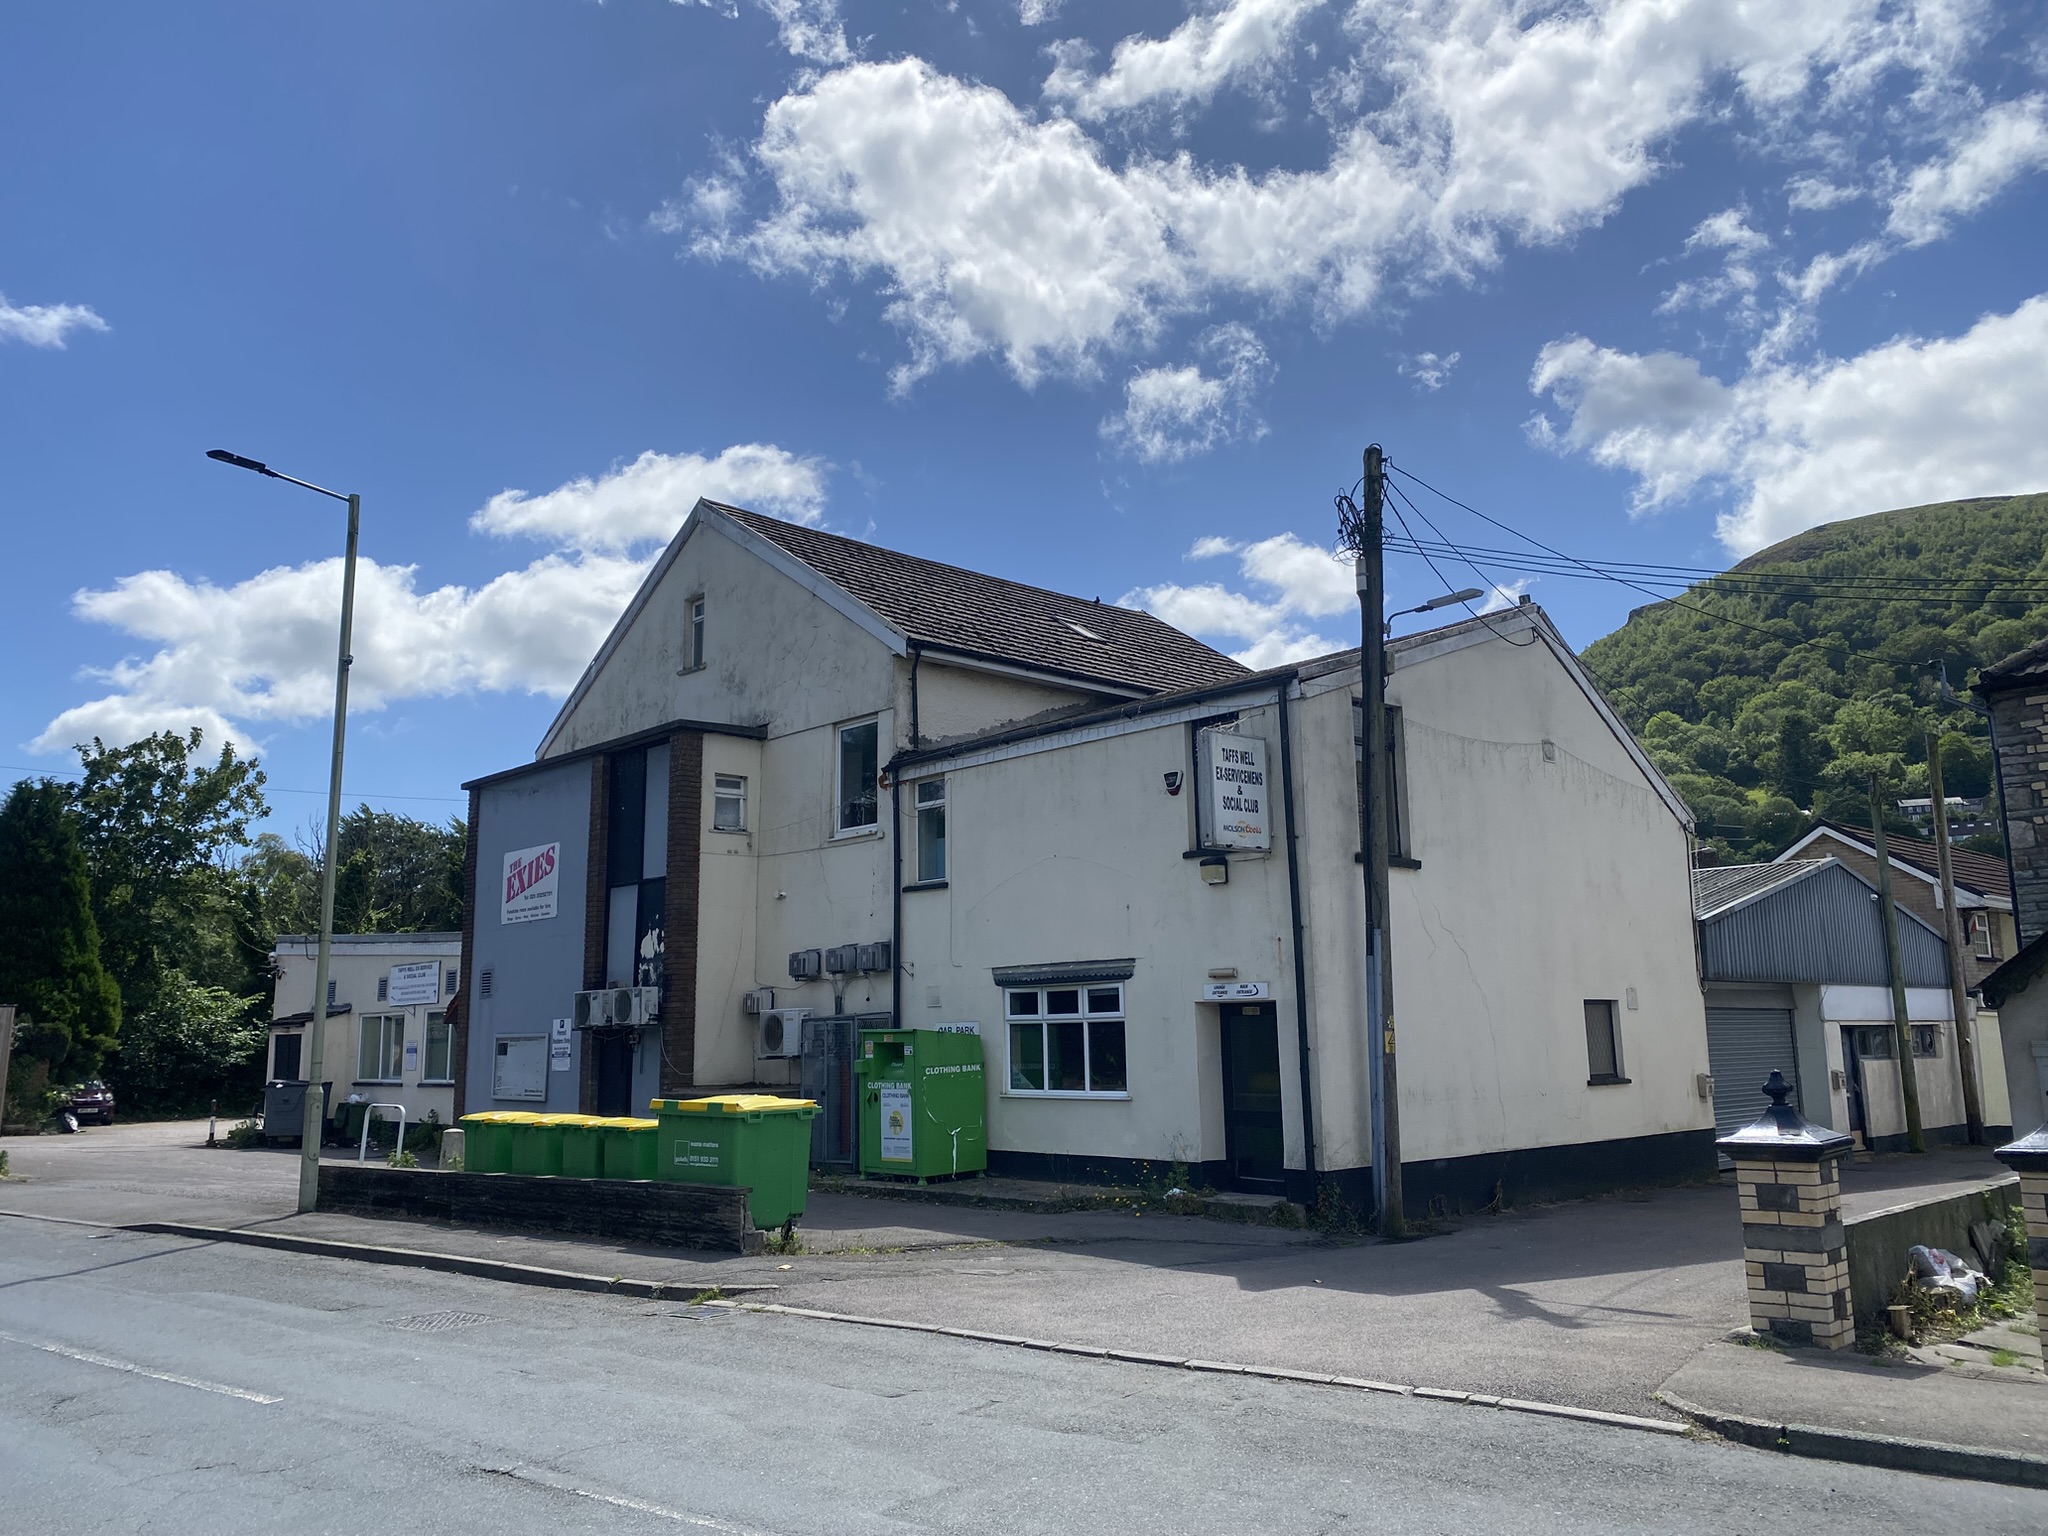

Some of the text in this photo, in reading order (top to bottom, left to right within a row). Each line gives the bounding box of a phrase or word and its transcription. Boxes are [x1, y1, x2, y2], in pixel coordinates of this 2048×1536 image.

[1222, 748, 1255, 766] TAFFS WELL
[1216, 766, 1263, 786] EX-SERVICEMENS
[1237, 785, 1243, 796] &
[1222, 795, 1259, 813] SOCIAL CLUB
[1223, 824, 1262, 834] MOLSON Coors
[509, 857, 522, 874] THE
[506, 845, 555, 904] EXIES
[956, 1027, 975, 1035] PARK
[925, 1064, 981, 1075] CLOTHING BANK
[896, 1081, 912, 1089] BANK
